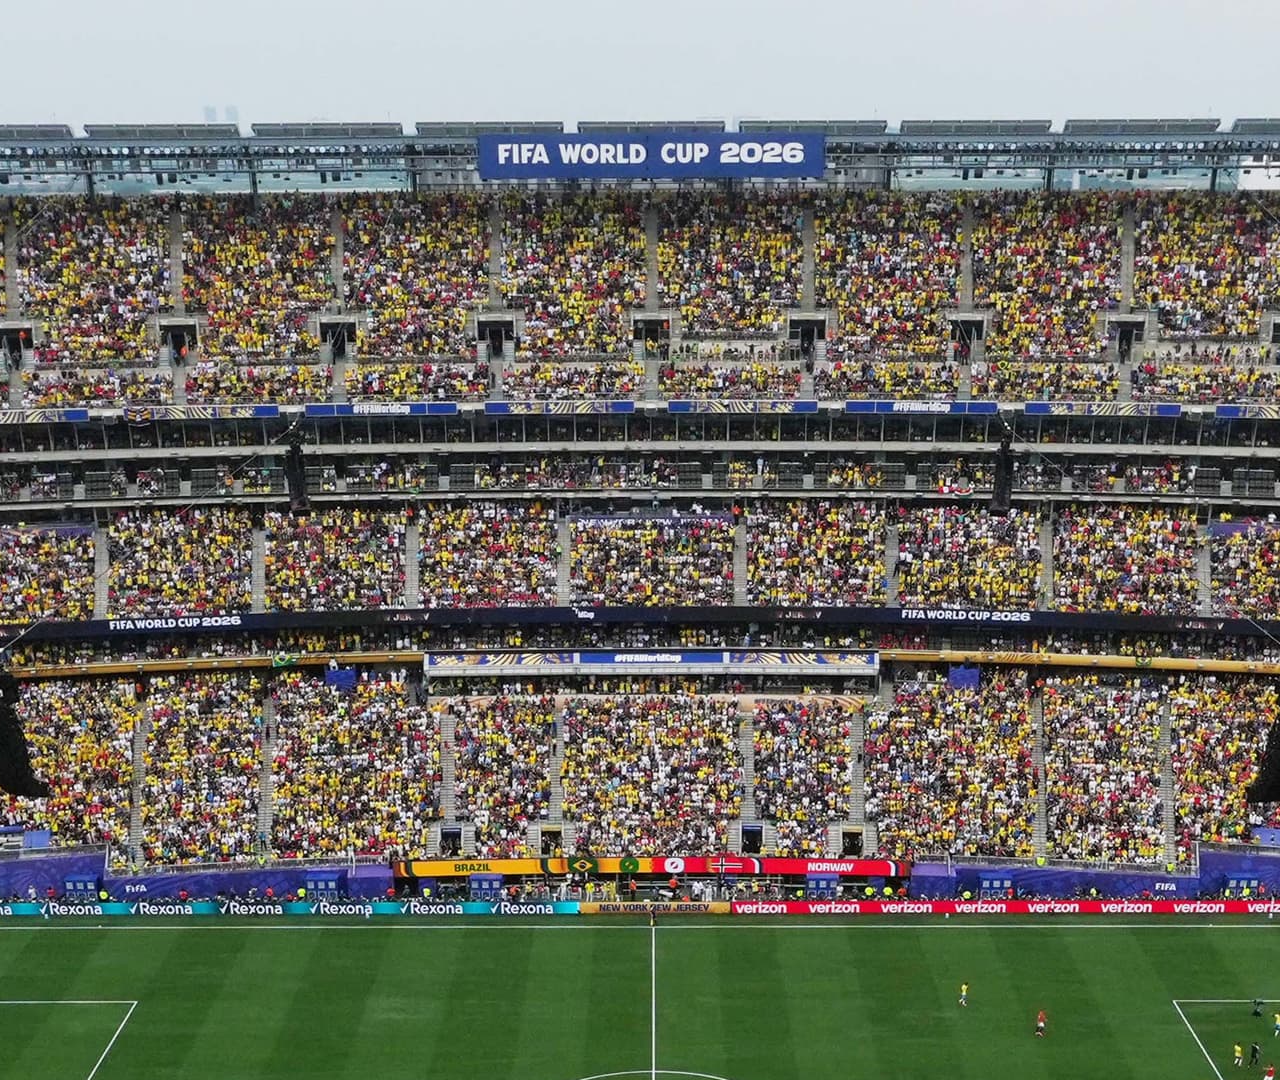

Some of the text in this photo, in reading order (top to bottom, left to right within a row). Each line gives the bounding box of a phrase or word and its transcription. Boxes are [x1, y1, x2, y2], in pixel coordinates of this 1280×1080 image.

[498, 141, 805, 165] FIFA WORLD CUP 2026
[901, 609, 1031, 622] FIFA WORLD CUP 2026
[109, 616, 242, 631] FIFA WORLD CUP 2026
[454, 863, 493, 873] BRAZIL
[807, 862, 855, 873] NORWAY
[126, 885, 148, 893] FIFA
[1155, 882, 1177, 892] FIFA
[49, 903, 103, 915] Rexona
[140, 903, 193, 915] Rexona
[230, 903, 283, 915] Rexona
[320, 903, 373, 915] Rexona
[410, 903, 464, 915] Rexona
[500, 903, 554, 915] Rexona
[599, 903, 621, 913] NEW
[622, 903, 649, 913] YORK
[674, 903, 710, 913] JERSEY
[736, 901, 788, 913] verizon
[808, 901, 860, 913] verizon
[880, 901, 932, 913] verizon
[955, 901, 1006, 913] verizon
[1028, 901, 1079, 913] verizon
[1101, 901, 1152, 913] verizon
[1173, 901, 1225, 913] verizon
